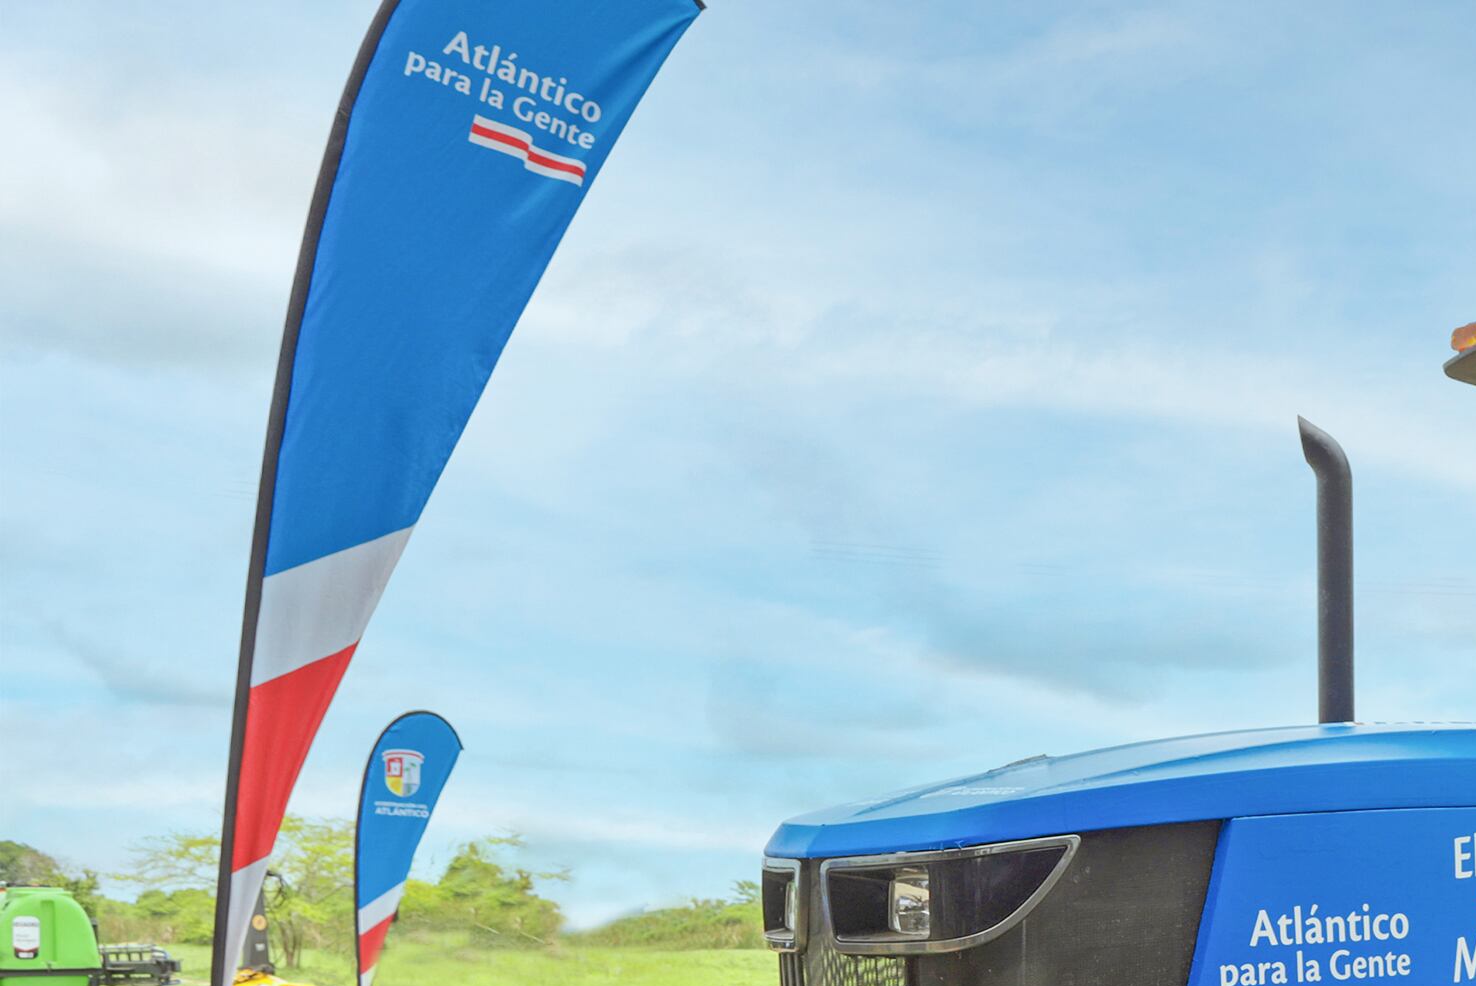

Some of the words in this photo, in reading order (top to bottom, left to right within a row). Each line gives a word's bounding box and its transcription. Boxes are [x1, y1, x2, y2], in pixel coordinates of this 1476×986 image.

[404, 51, 472, 95] para
[479, 77, 504, 110] la
[513, 96, 595, 149] Gente
[443, 31, 601, 122] Atlántico
[1249, 903, 1409, 947] Atlántico
[1296, 950, 1321, 983] la
[1329, 949, 1411, 980] Gente
